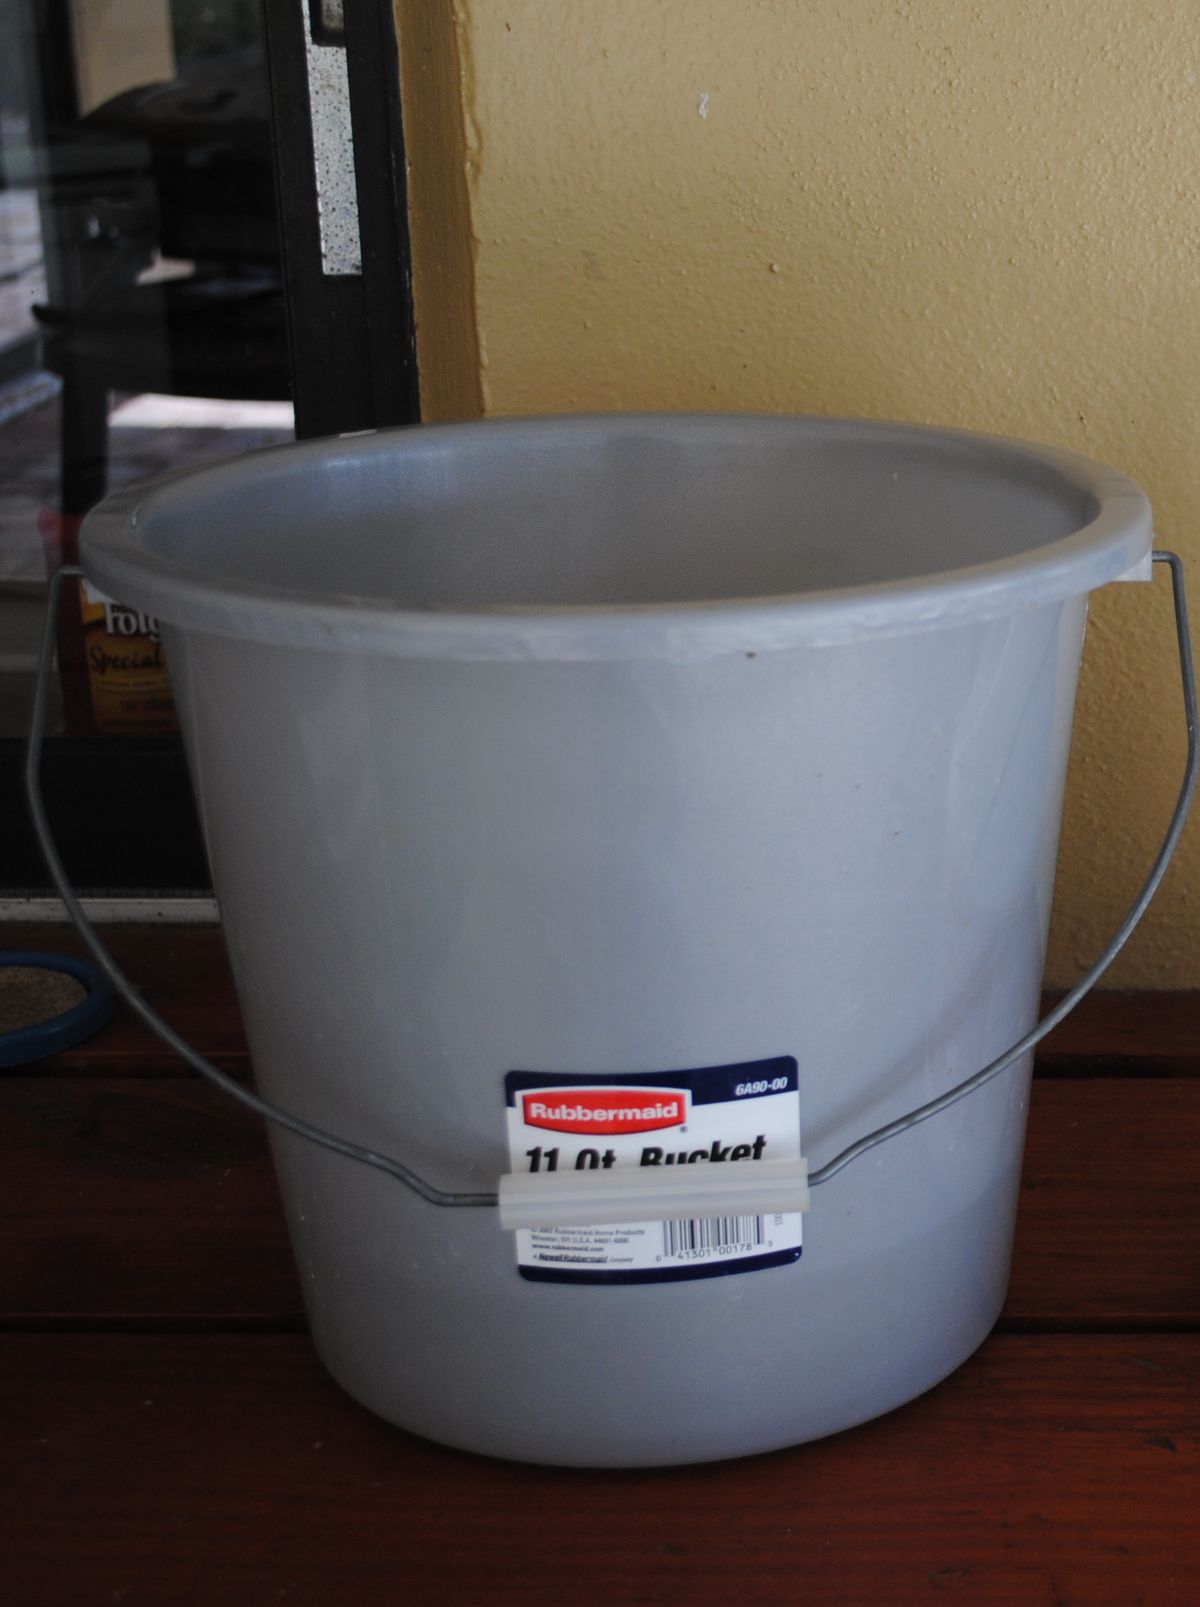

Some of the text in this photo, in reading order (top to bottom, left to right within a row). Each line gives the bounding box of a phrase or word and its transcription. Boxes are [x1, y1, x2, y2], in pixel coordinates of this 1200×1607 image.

[735, 1077, 788, 1096] 6A90-00
[530, 1102, 678, 1122] Rubbermaid
[526, 1146, 559, 1172] 11
[677, 1248, 711, 1260] 41301
[719, 1242, 752, 1256] 00178
